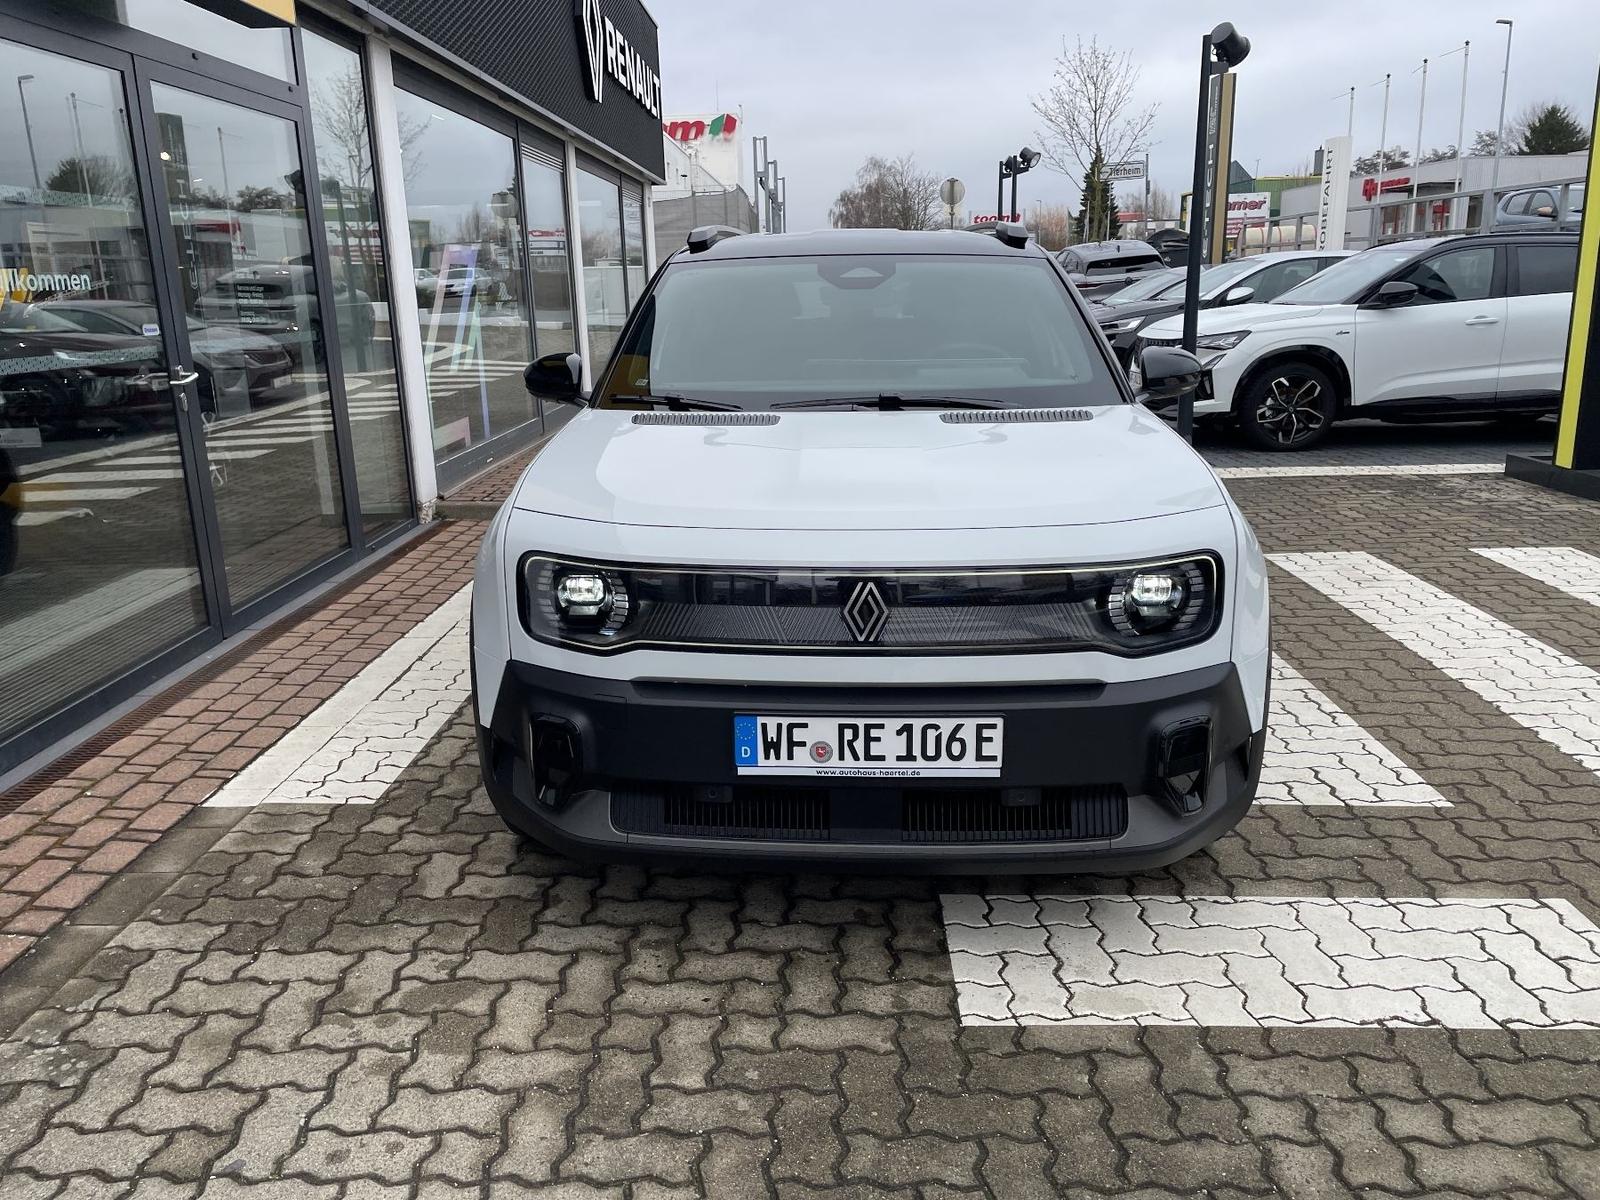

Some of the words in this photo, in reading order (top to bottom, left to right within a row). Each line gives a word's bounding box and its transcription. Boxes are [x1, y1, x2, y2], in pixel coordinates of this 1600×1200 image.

[604, 16, 660, 119] RENAULT
[1109, 166, 1141, 176] Tierheim
[0, 267, 92, 292] llkommen
[741, 746, 750, 757] D
[760, 722, 809, 760] WF
[837, 723, 886, 762] RE
